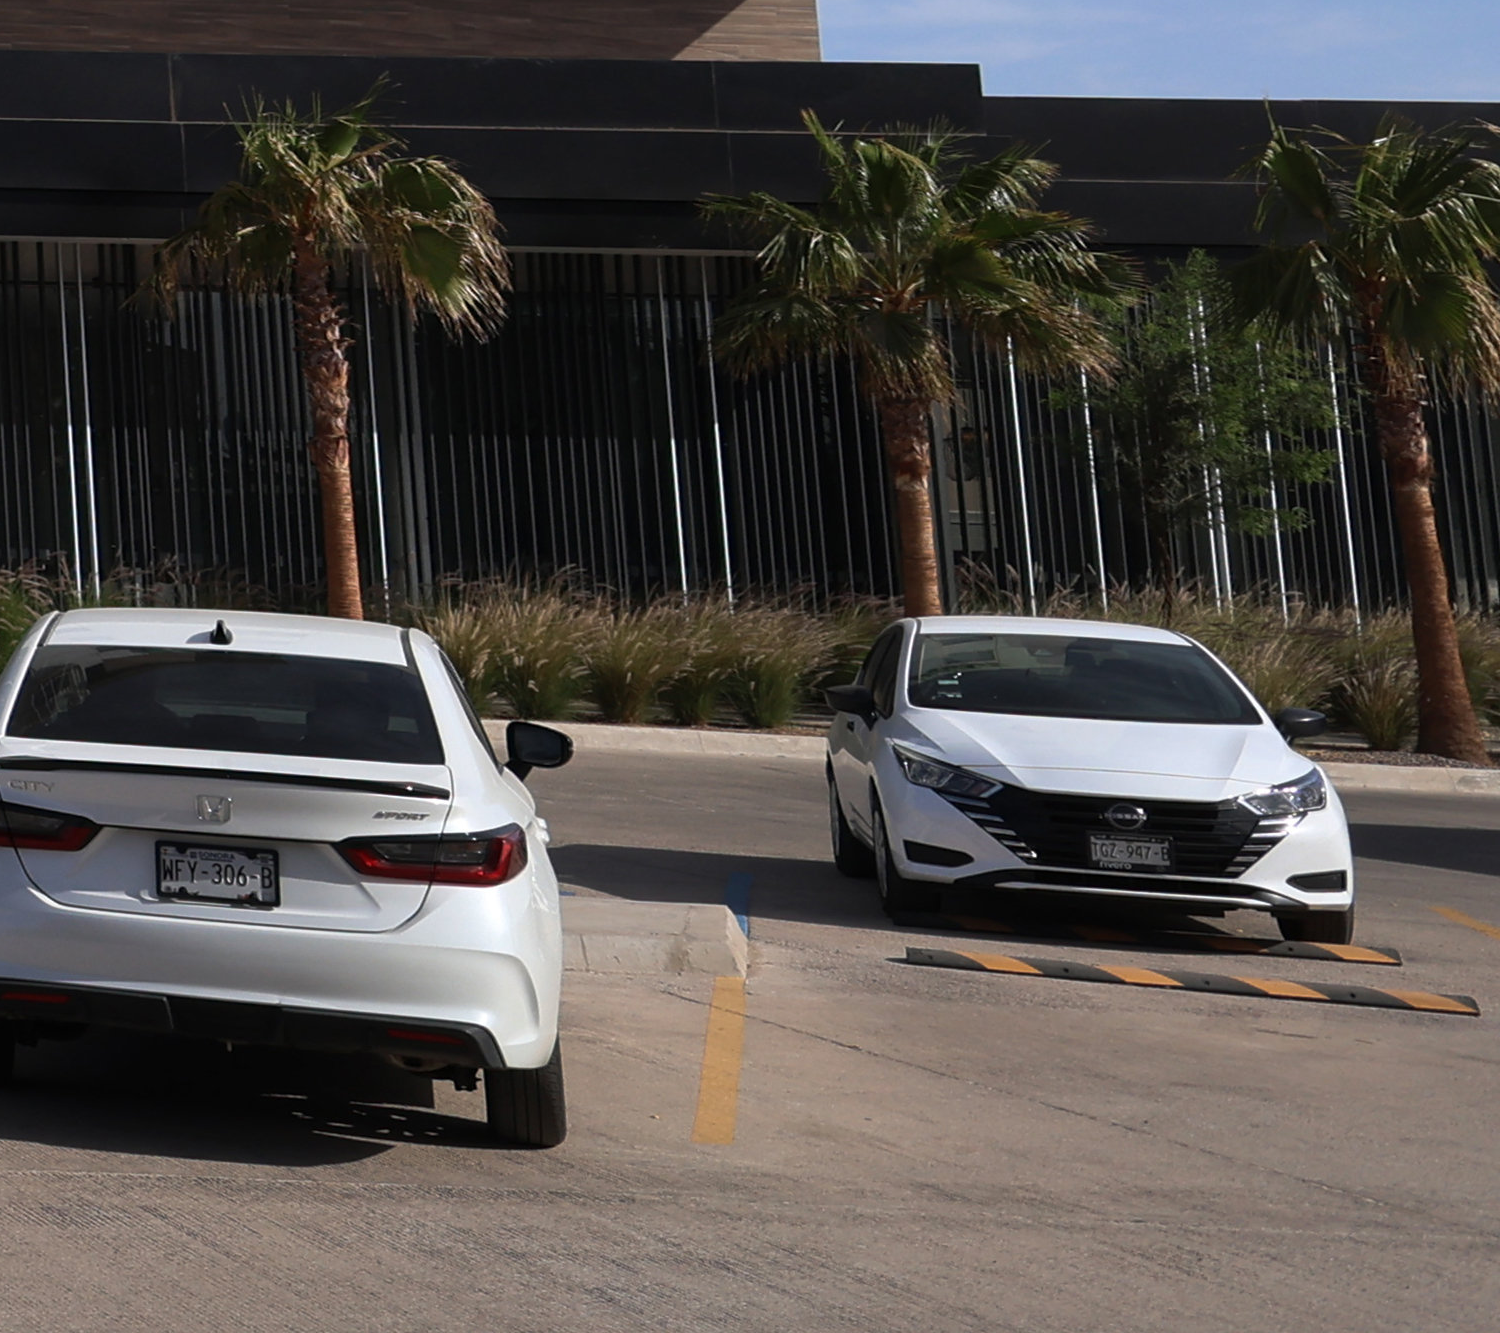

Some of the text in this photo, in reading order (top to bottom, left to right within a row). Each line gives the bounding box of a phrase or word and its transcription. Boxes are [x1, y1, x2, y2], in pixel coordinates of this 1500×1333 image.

[7, 780, 54, 792] CITY
[372, 810, 430, 821] SPORT
[198, 851, 236, 861] SONORA
[162, 859, 273, 889] WFY-306-B
